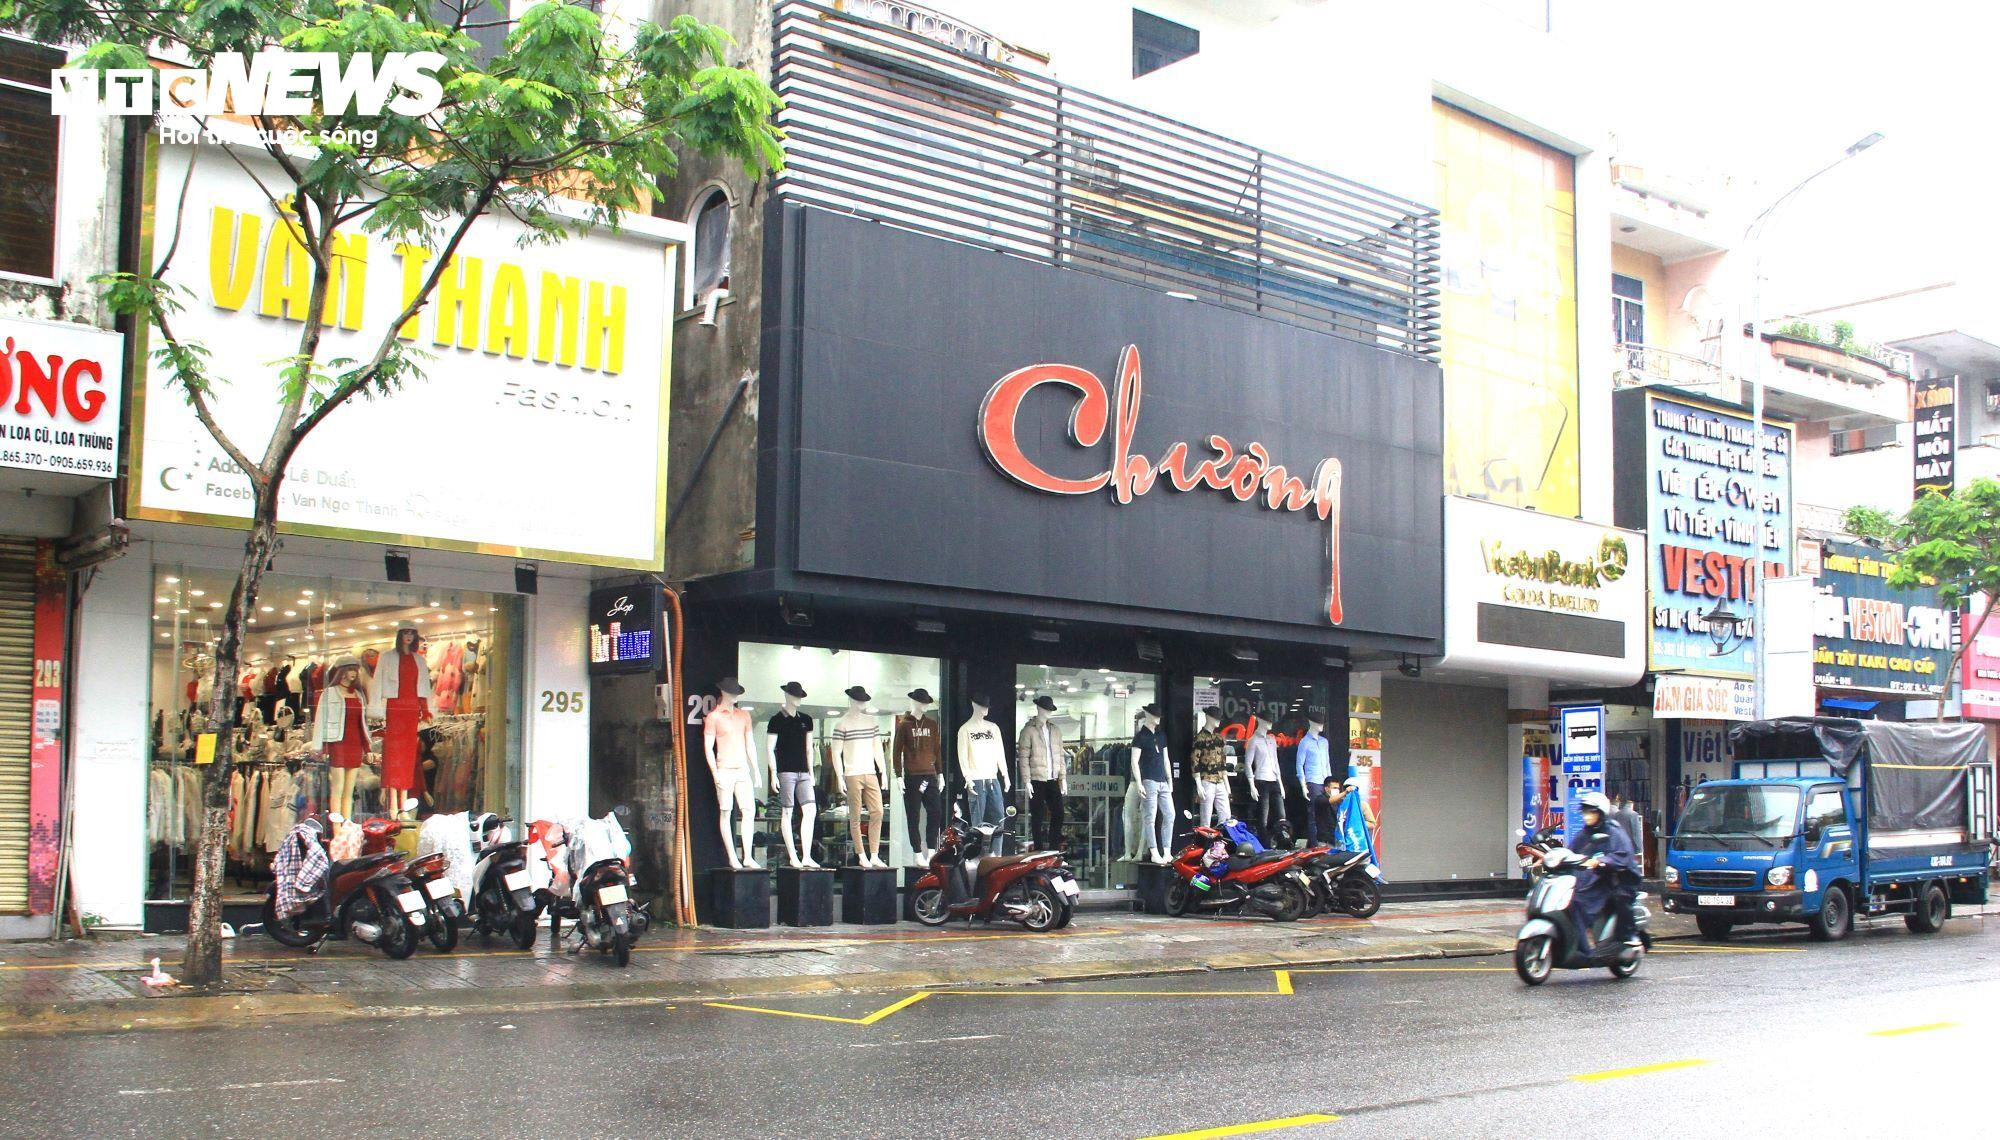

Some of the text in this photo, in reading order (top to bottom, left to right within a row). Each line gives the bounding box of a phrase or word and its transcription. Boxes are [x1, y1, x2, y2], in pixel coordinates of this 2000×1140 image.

[392, 241, 628, 376] THANH
[1916, 411, 1952, 436] MẮT
[11, 426, 31, 442] LOA
[55, 430, 76, 447] LOA
[78, 432, 113, 451] THÙNG
[1917, 436, 1950, 459] MÔI
[1915, 459, 1952, 480] MÀY
[607, 596, 634, 616] Shop
[1848, 597, 1904, 645] VESTON
[540, 690, 584, 714] 295
[1356, 755, 1373, 767] 305
